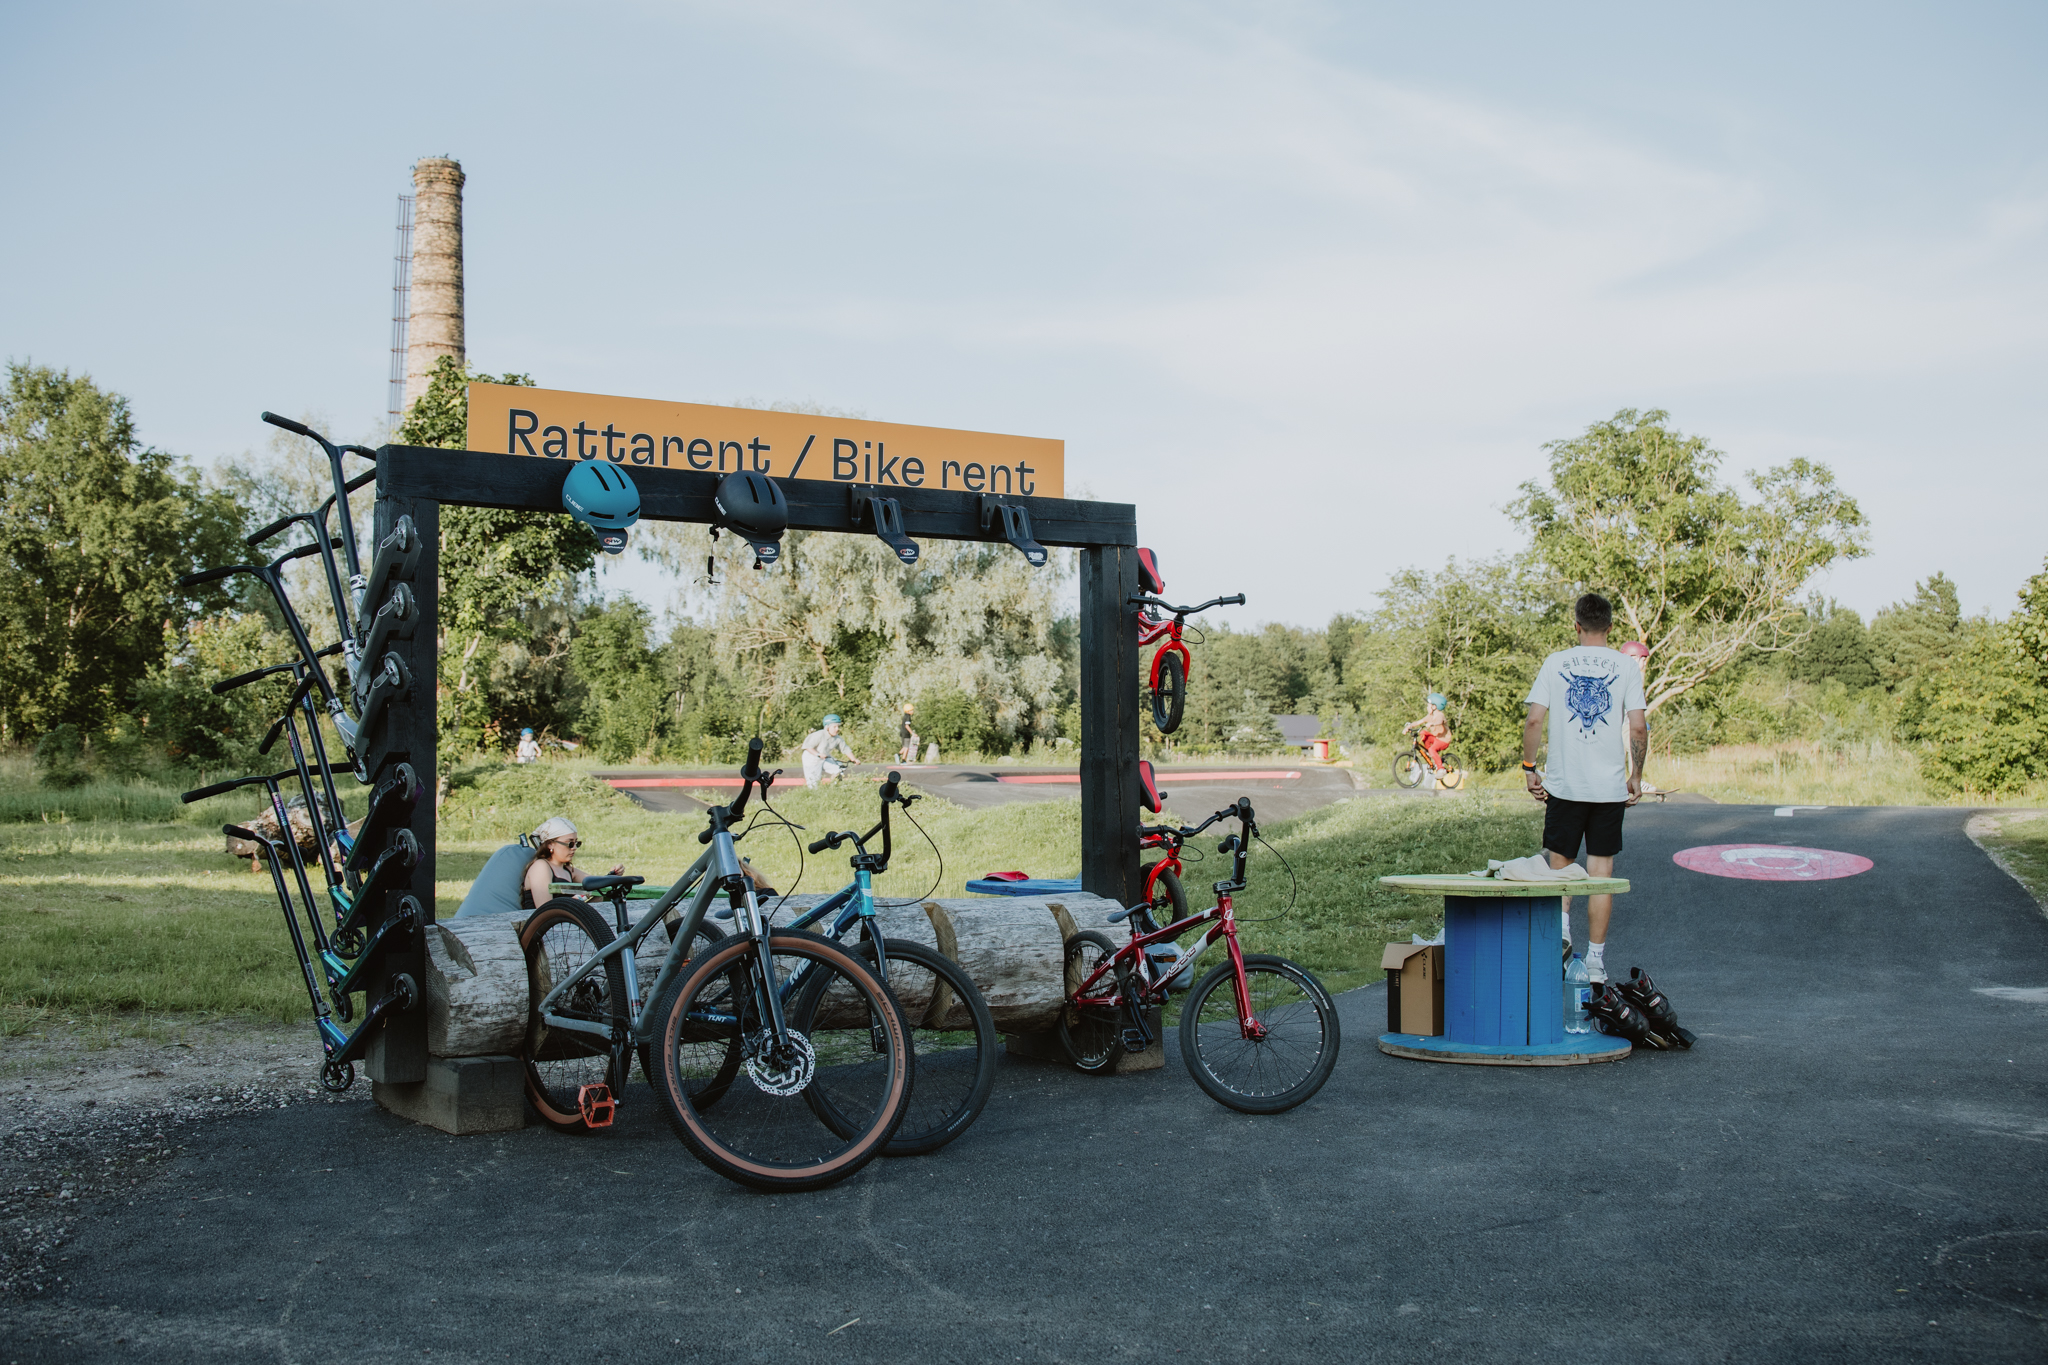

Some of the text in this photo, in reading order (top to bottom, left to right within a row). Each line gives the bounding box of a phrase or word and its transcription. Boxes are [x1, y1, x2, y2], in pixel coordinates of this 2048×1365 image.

[508, 408, 1036, 496] Rattarent / Bike rent
[708, 1014, 727, 1023] TLNT
[876, 992, 903, 1080] SCHWALBE
[667, 1016, 687, 1111] BILLY BONKERS
